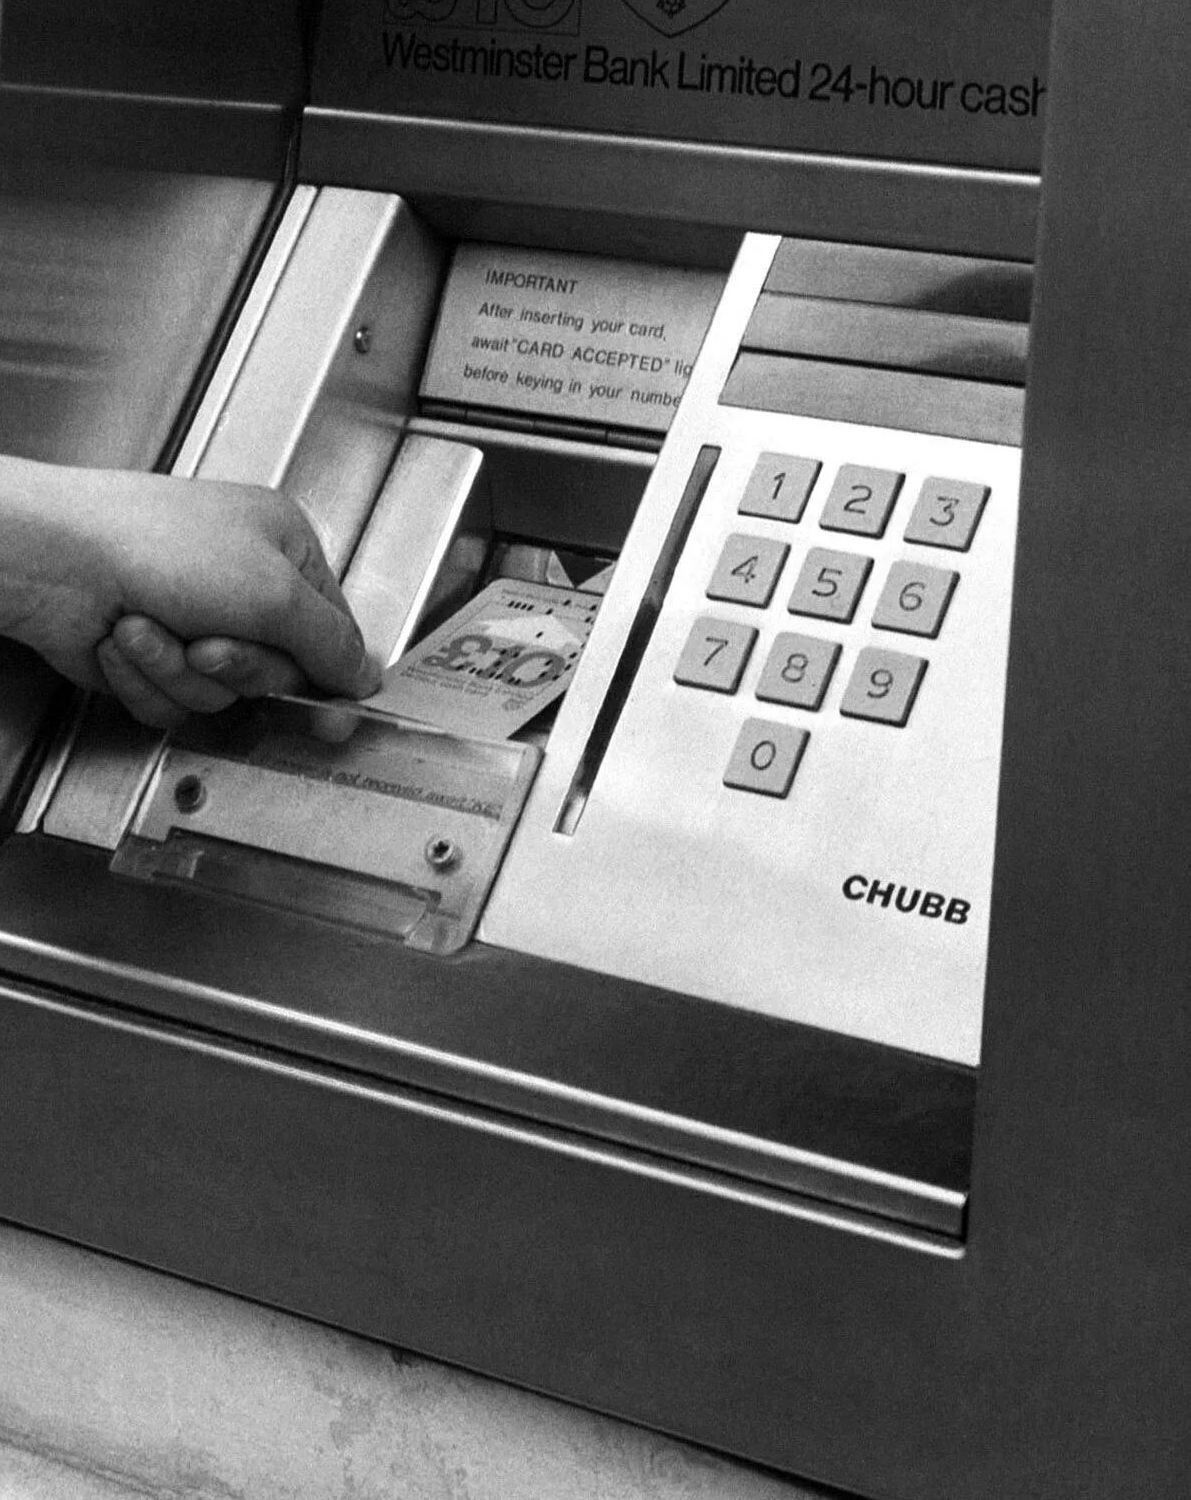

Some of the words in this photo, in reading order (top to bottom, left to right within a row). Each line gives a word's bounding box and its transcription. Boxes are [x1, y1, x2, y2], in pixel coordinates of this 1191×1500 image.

[381, 32, 577, 84] Westminster
[582, 45, 671, 90] Bank
[676, 52, 802, 99] Limited
[808, 63, 954, 112] 24-hour
[485, 269, 578, 295] IMPORTANT
[471, 336, 509, 353] await
[478, 302, 514, 320] After
[519, 308, 584, 332] inserting
[591, 318, 623, 336] your
[629, 321, 667, 342] card,
[463, 364, 509, 384] before
[516, 373, 564, 395] keying
[568, 378, 583, 393] in
[589, 381, 624, 400] your
[771, 471, 787, 500] 1
[844, 485, 873, 514] 2
[929, 496, 961, 526] 3
[731, 555, 760, 584] 4
[812, 568, 843, 598] 5
[899, 582, 927, 612] 6
[704, 637, 729, 667] 7
[781, 653, 809, 684] 8
[867, 668, 895, 699] 9
[750, 740, 778, 771] 0
[841, 873, 972, 926] CHUBB
